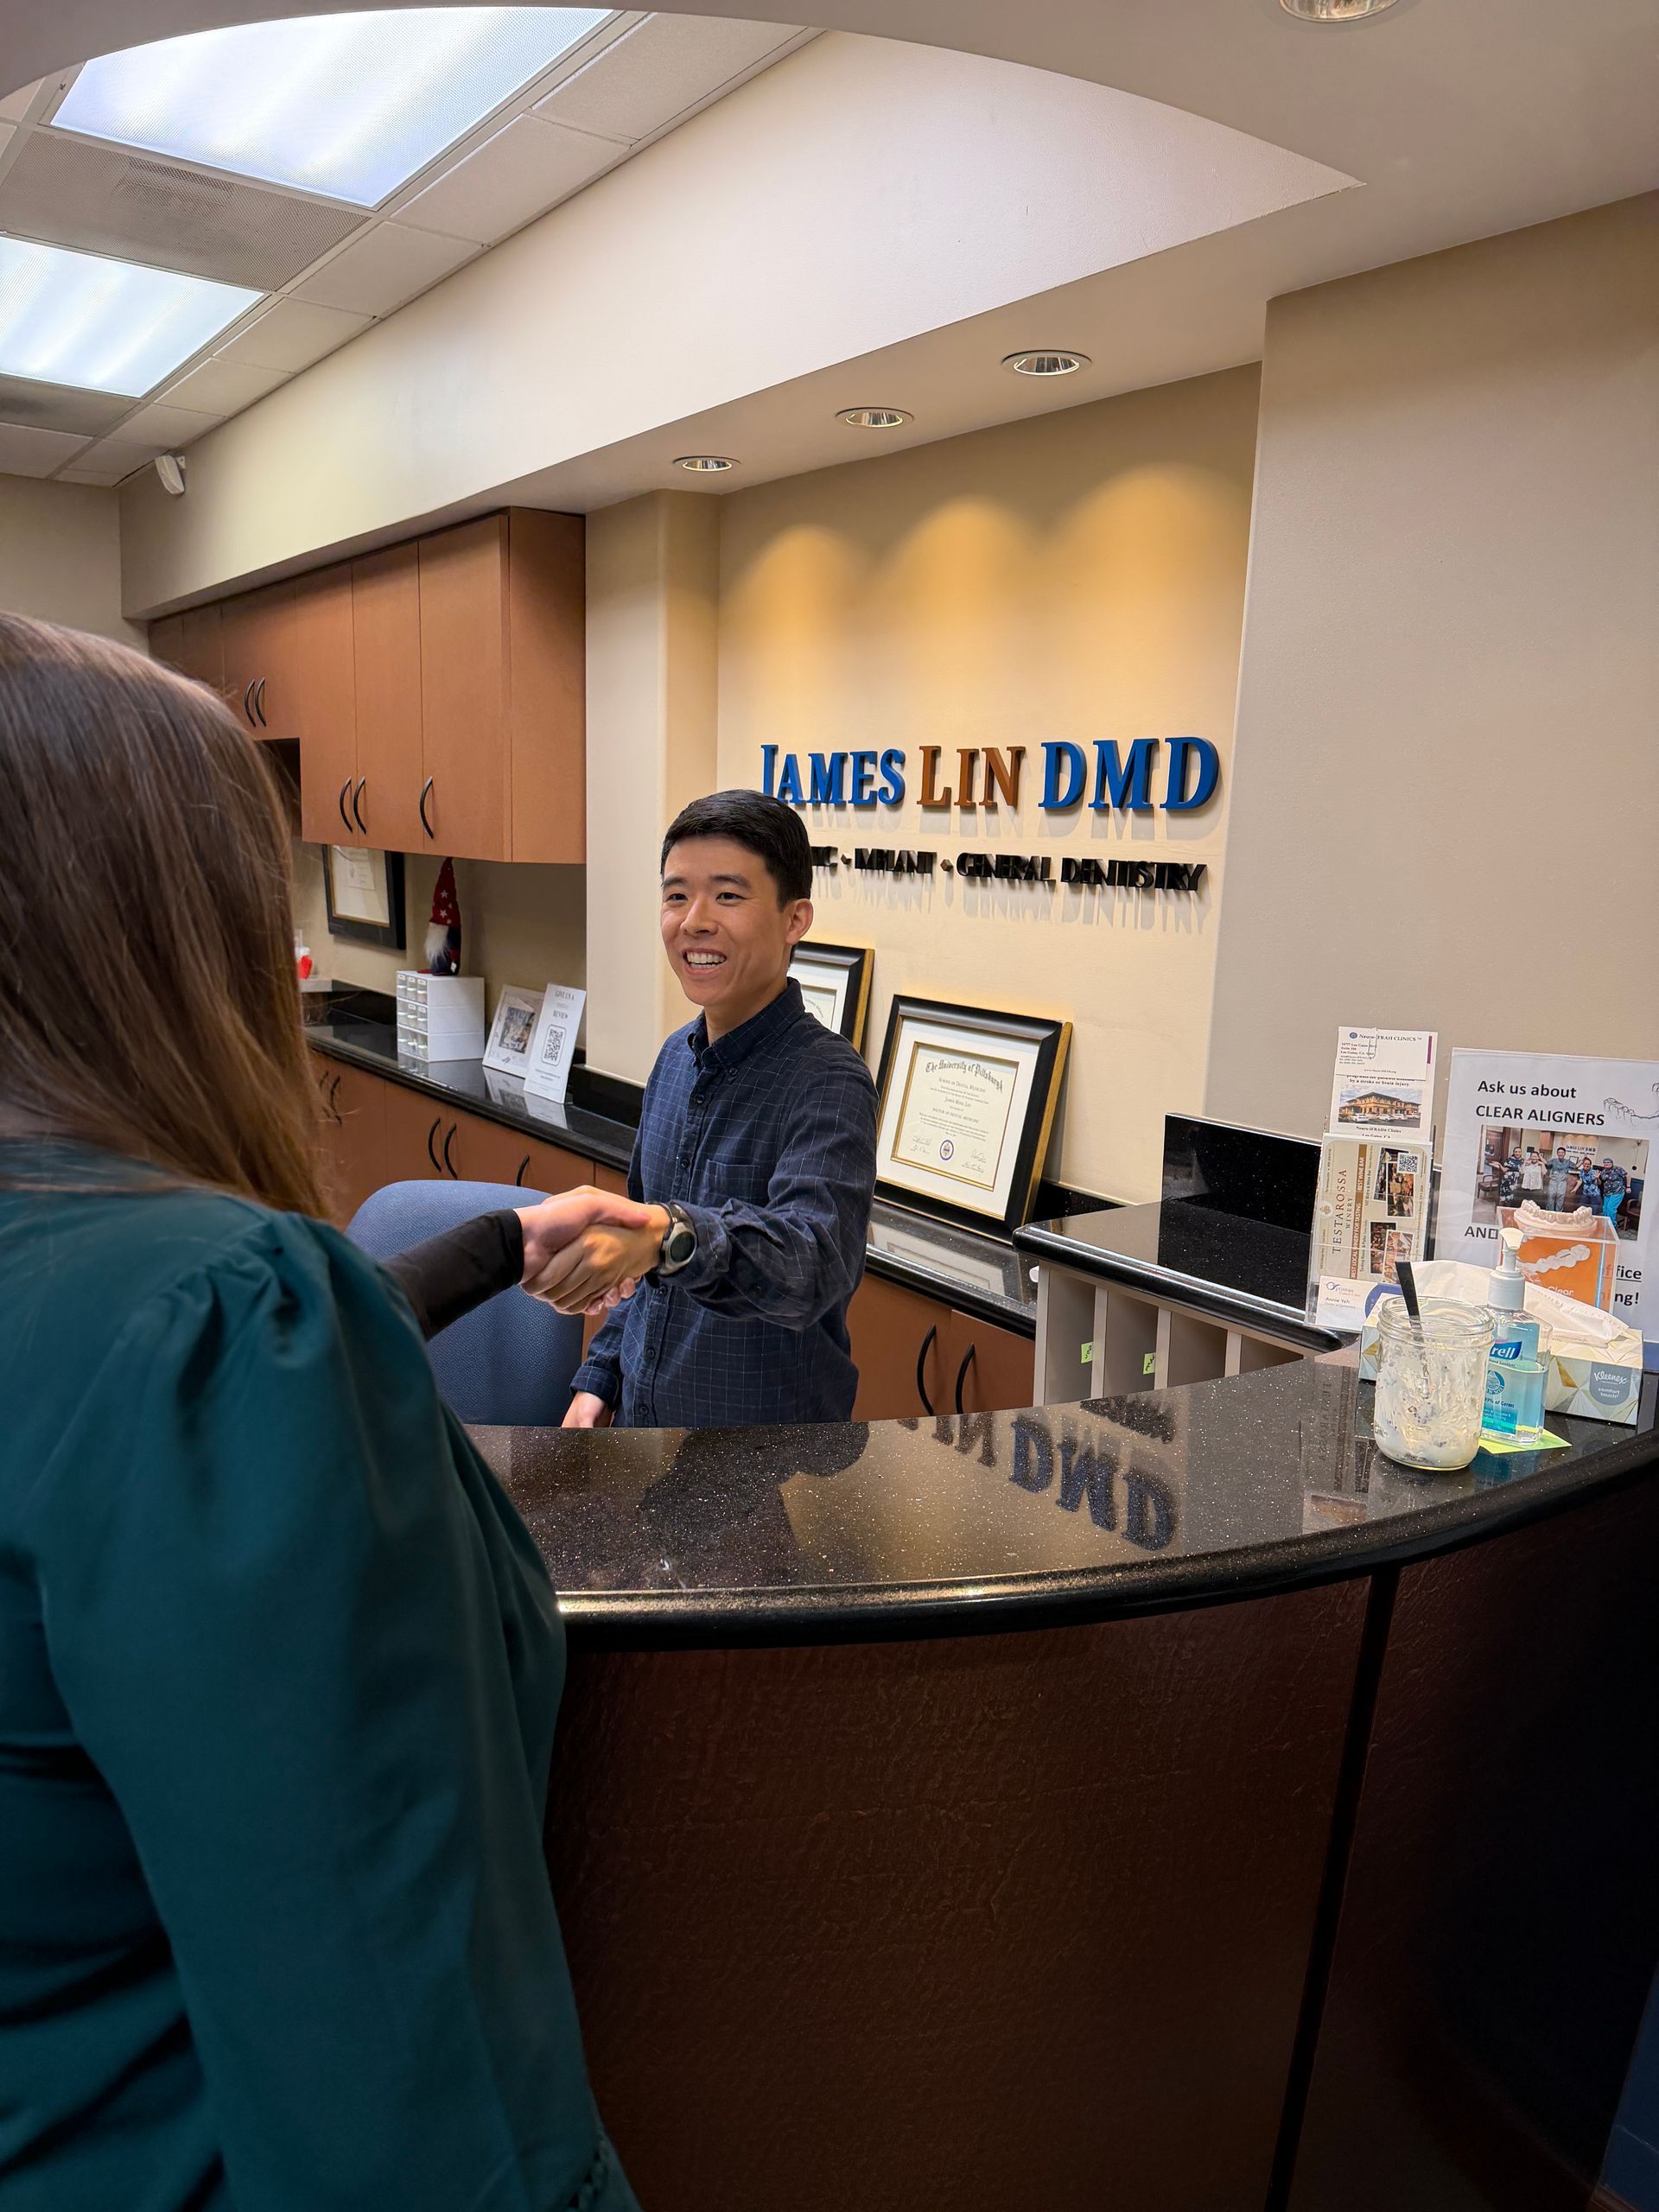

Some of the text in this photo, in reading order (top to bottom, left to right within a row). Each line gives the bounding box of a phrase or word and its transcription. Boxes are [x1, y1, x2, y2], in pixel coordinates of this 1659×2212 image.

[760, 736, 1220, 810] JAMES LIN DMD
[957, 852, 1056, 882] GENERAL
[1061, 857, 1207, 891] DENTISTRY
[925, 1061, 938, 1073] The
[938, 1059, 968, 1073] University
[968, 1063, 976, 1072] of
[975, 1063, 1003, 1094] Pittsburgh
[1478, 1080, 1577, 1099] Ask us about
[1476, 1105, 1605, 1126] CLEAR ALIGNERS
[1332, 1169, 1346, 1254] TESTAROSSA
[1345, 1198, 1354, 1230] WINERY
[1491, 1346, 1516, 1358] rell
[1593, 1370, 1627, 1384] Kleenex
